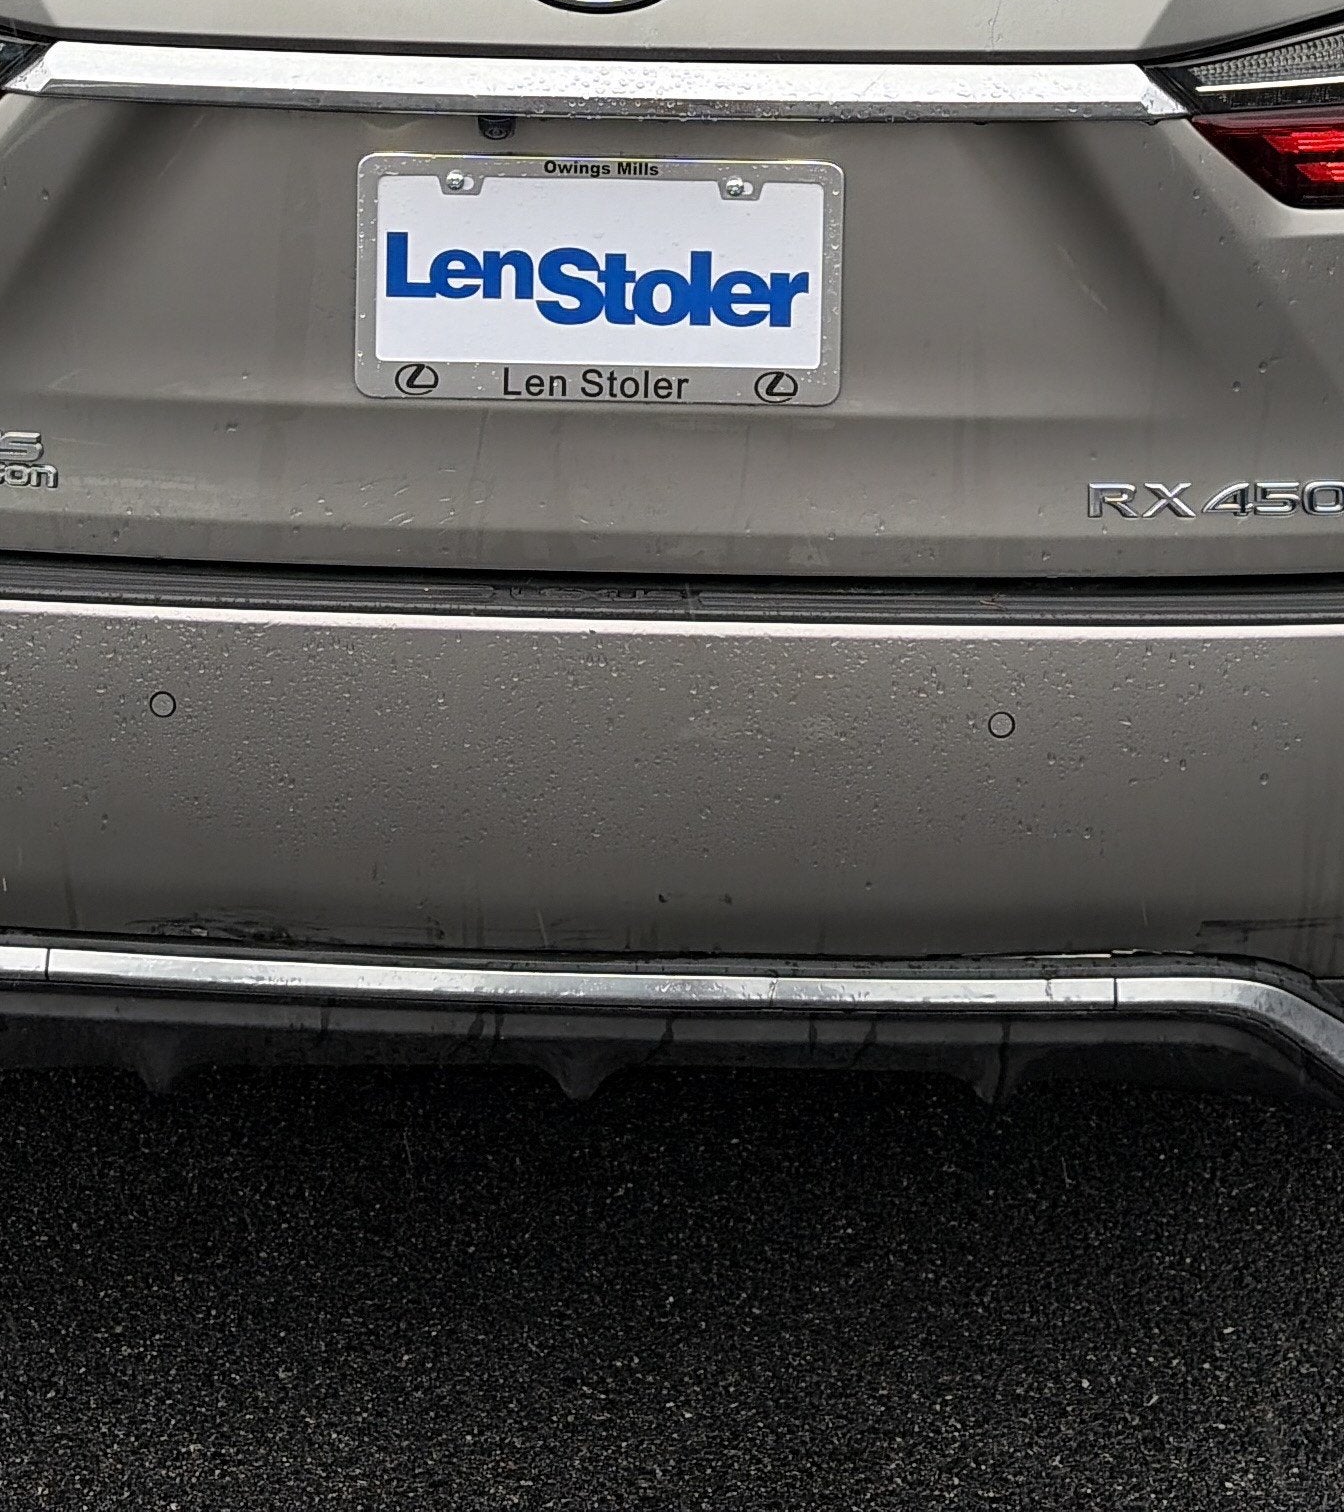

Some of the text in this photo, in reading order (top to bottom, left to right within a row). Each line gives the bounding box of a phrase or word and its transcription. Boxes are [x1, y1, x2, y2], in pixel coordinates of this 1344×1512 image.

[543, 159, 659, 178] Owings Mills
[503, 366, 689, 400] Len Stoler
[1087, 482, 1197, 519] RX
